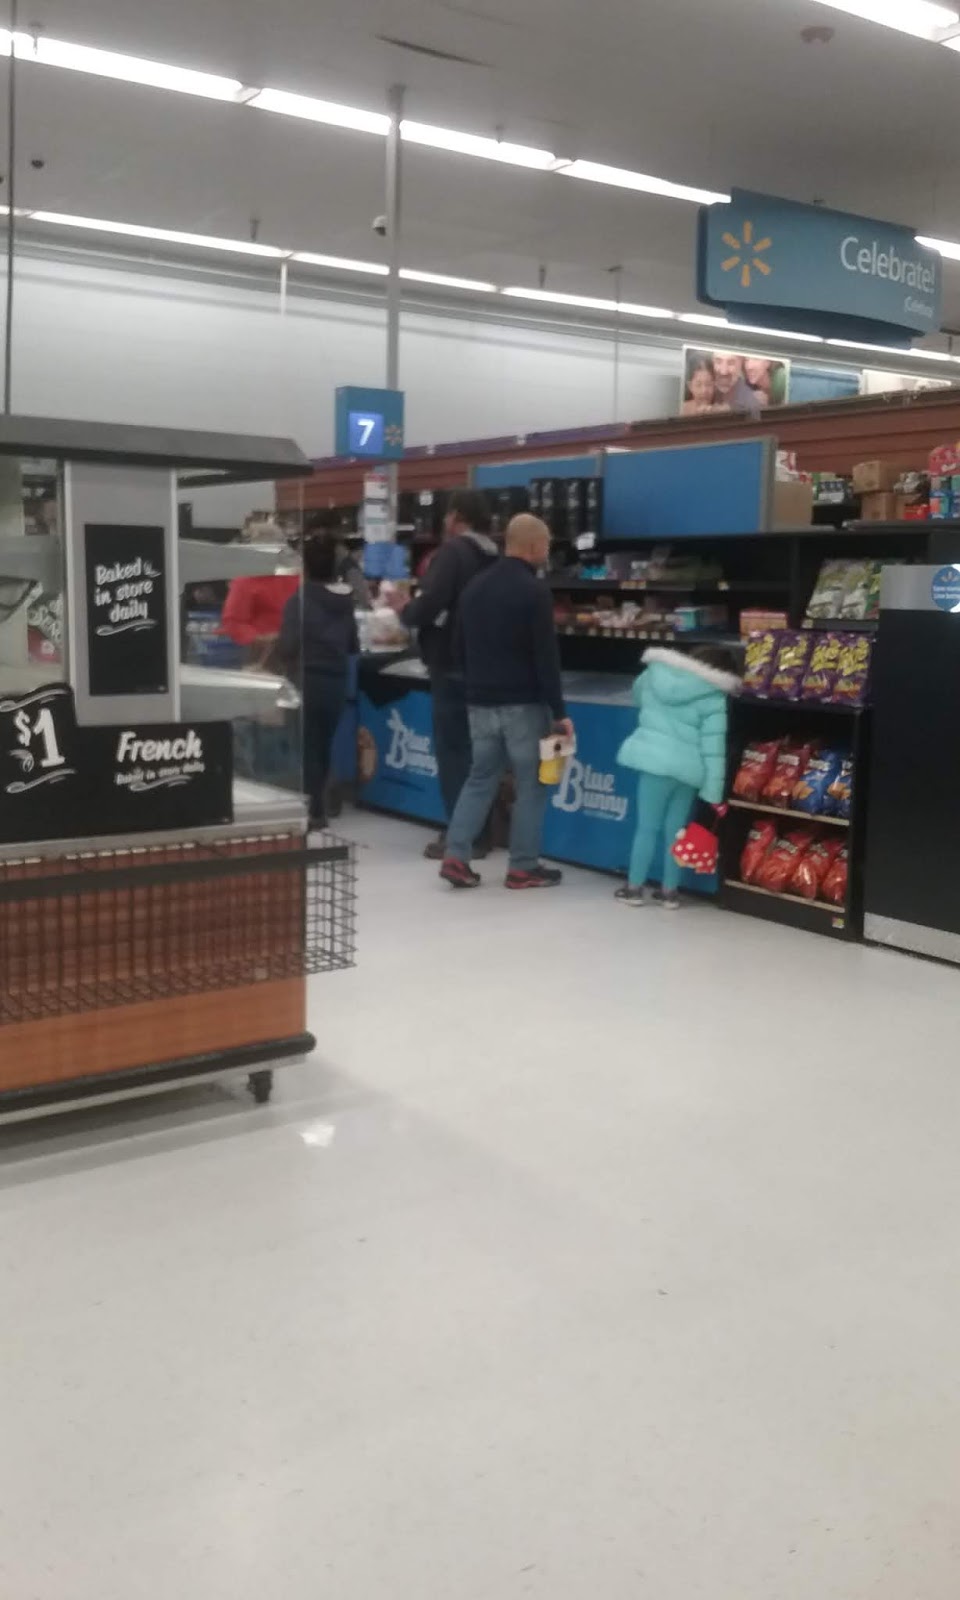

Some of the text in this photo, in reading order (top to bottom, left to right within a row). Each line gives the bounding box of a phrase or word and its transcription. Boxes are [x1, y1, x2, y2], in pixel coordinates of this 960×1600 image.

[841, 236, 935, 293] Celebrate!
[357, 418, 375, 446] 7
[96, 557, 142, 586] Baked
[95, 580, 153, 606] in store
[110, 599, 148, 623] daily
[14, 708, 65, 767] $1
[117, 729, 203, 762] French
[553, 756, 615, 812] Blue
